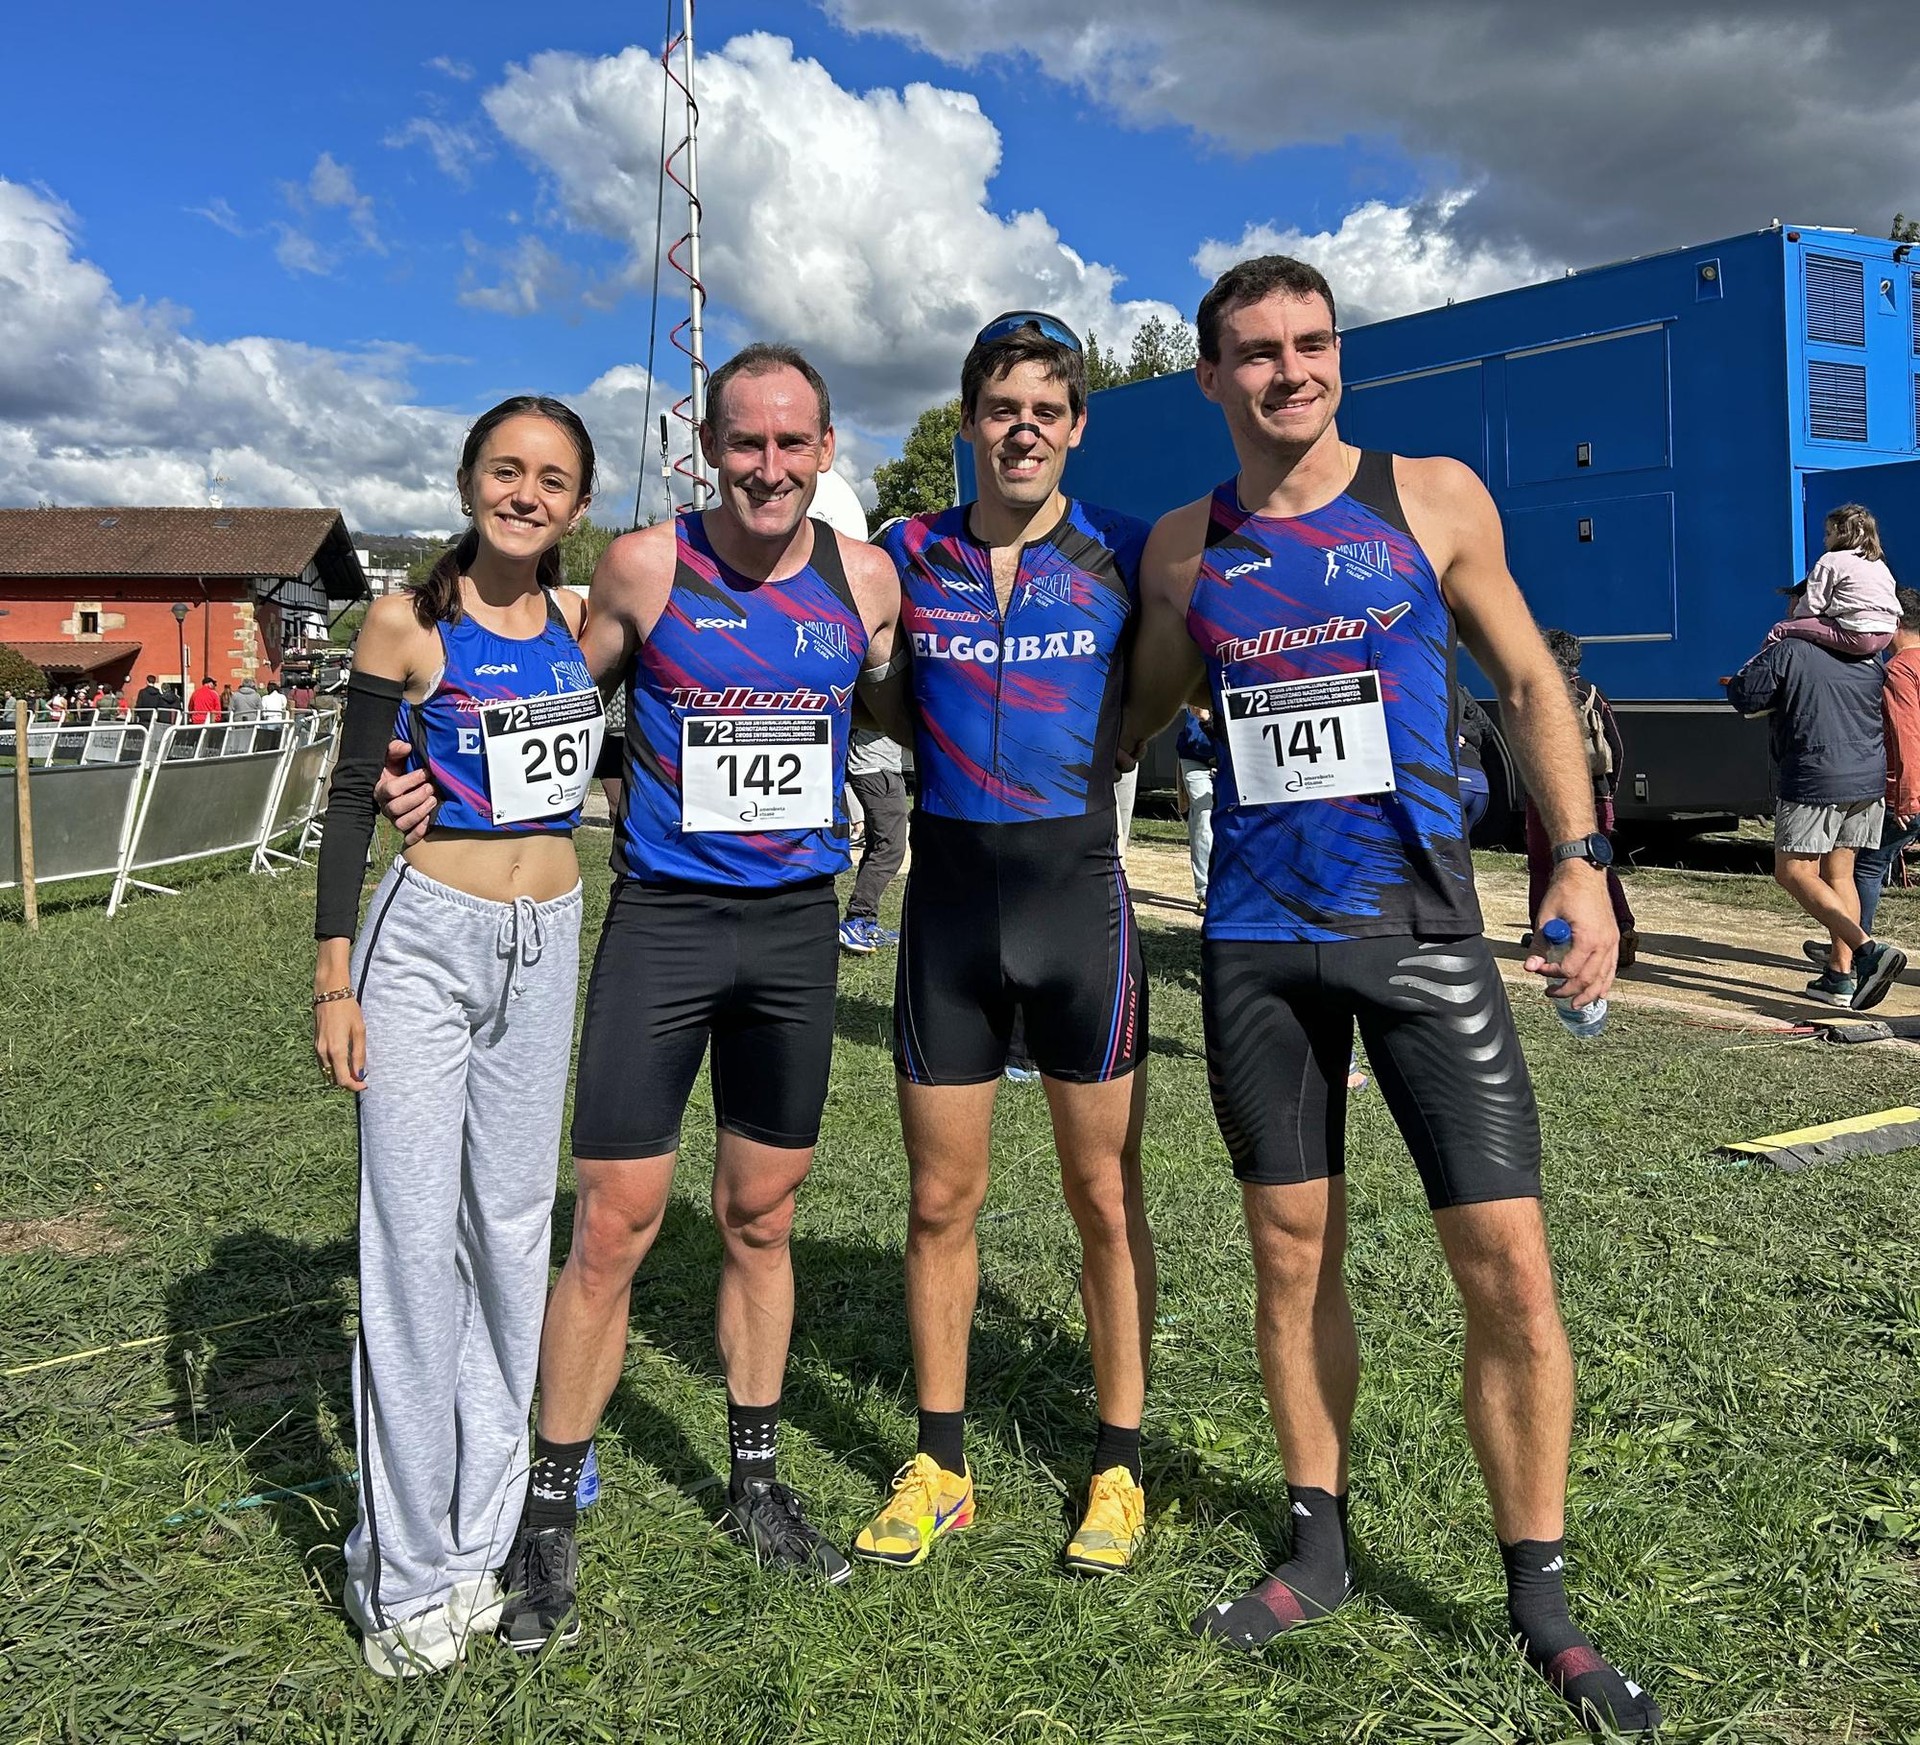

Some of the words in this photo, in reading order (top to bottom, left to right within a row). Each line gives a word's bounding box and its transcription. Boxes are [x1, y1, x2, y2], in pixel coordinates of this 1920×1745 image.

[914, 606, 981, 623] Telleria
[1216, 615, 1368, 668] Telleria
[671, 686, 830, 712] Telleria
[1240, 690, 1270, 715] 72
[498, 705, 531, 732] 72
[703, 721, 734, 744] 72
[1261, 716, 1346, 767] 141
[521, 728, 590, 784] 261
[716, 753, 803, 797] 142
[736, 1447, 776, 1460] EPIC
